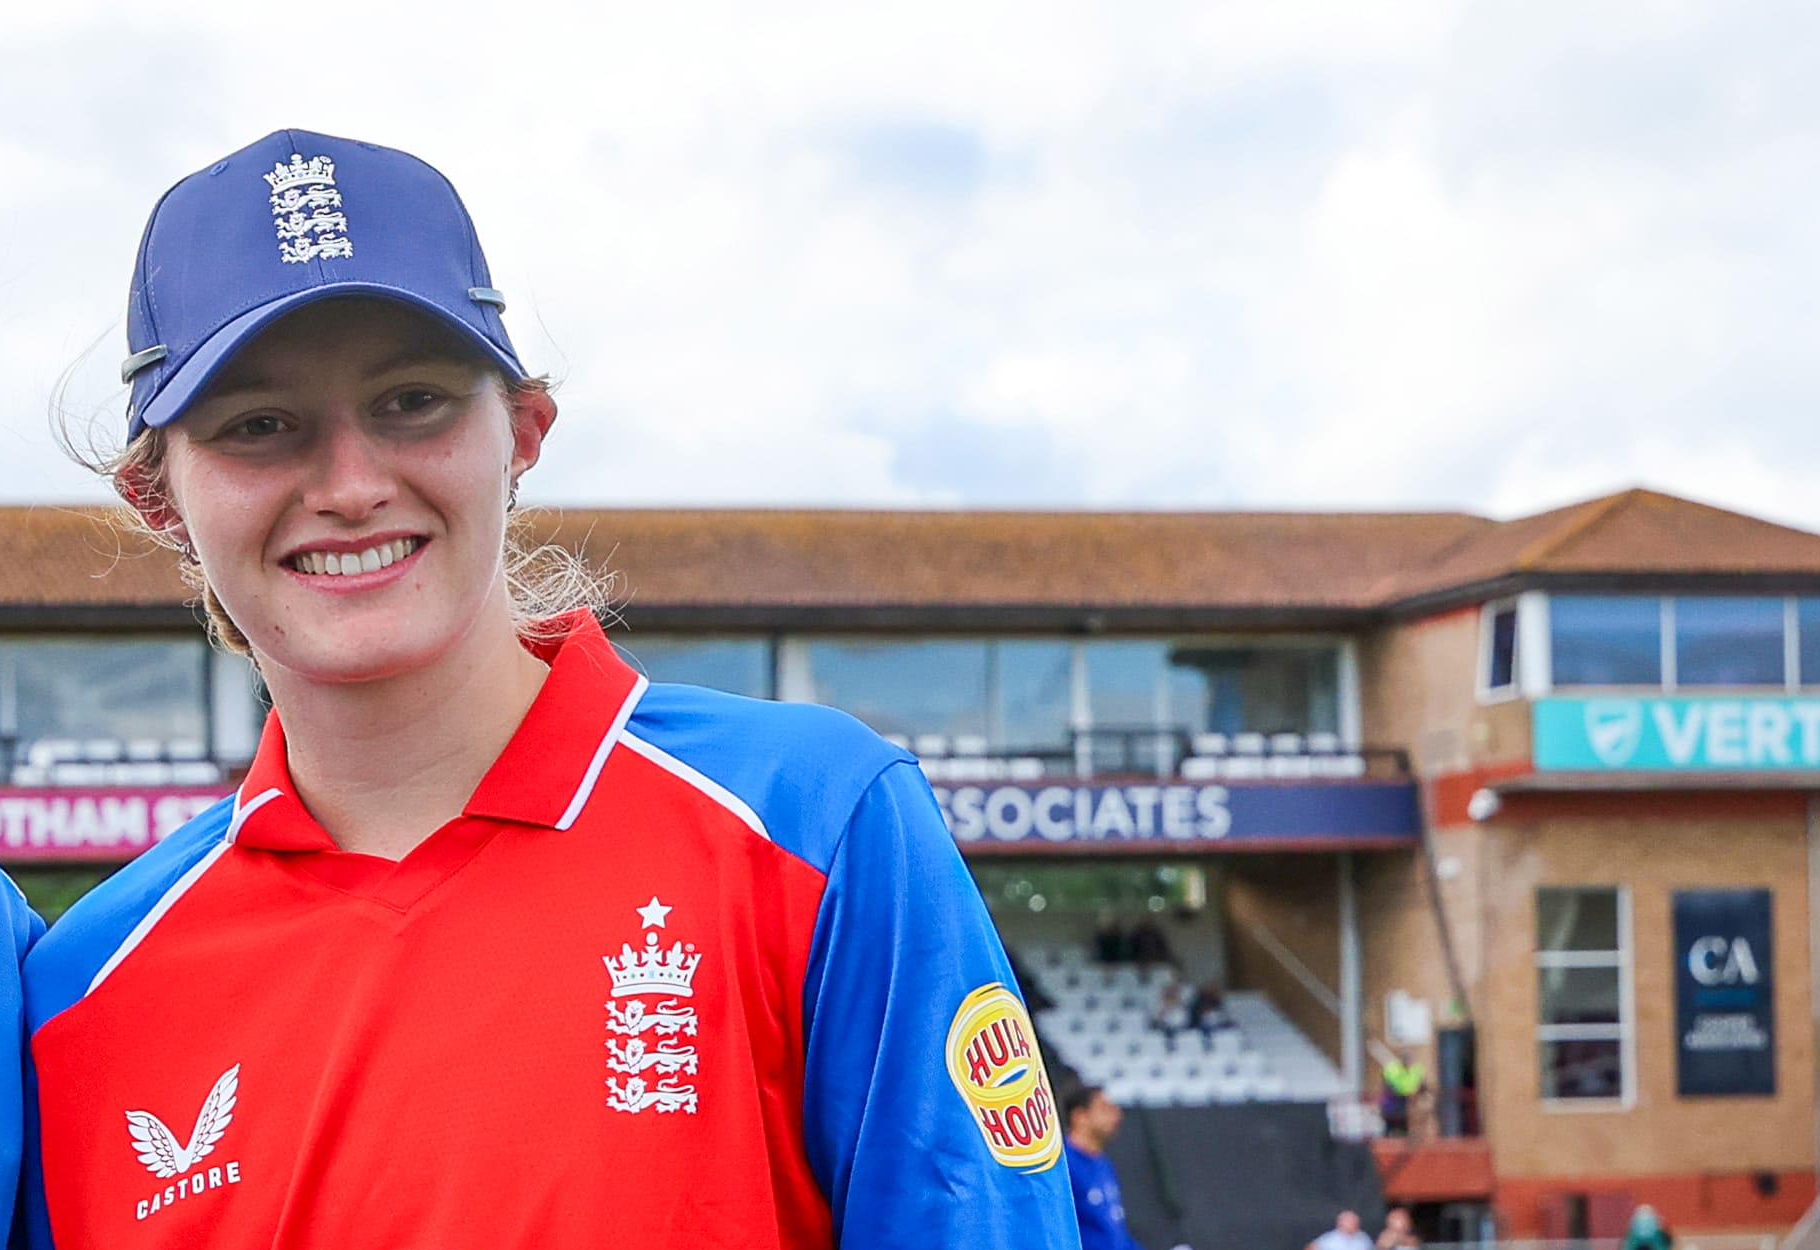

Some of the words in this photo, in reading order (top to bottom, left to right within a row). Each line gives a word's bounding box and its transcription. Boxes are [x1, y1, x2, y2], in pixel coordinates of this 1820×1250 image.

[935, 785, 1231, 841] SOCIATES
[966, 1018, 1032, 1087] HULA
[136, 1161, 242, 1220] CASTORE
